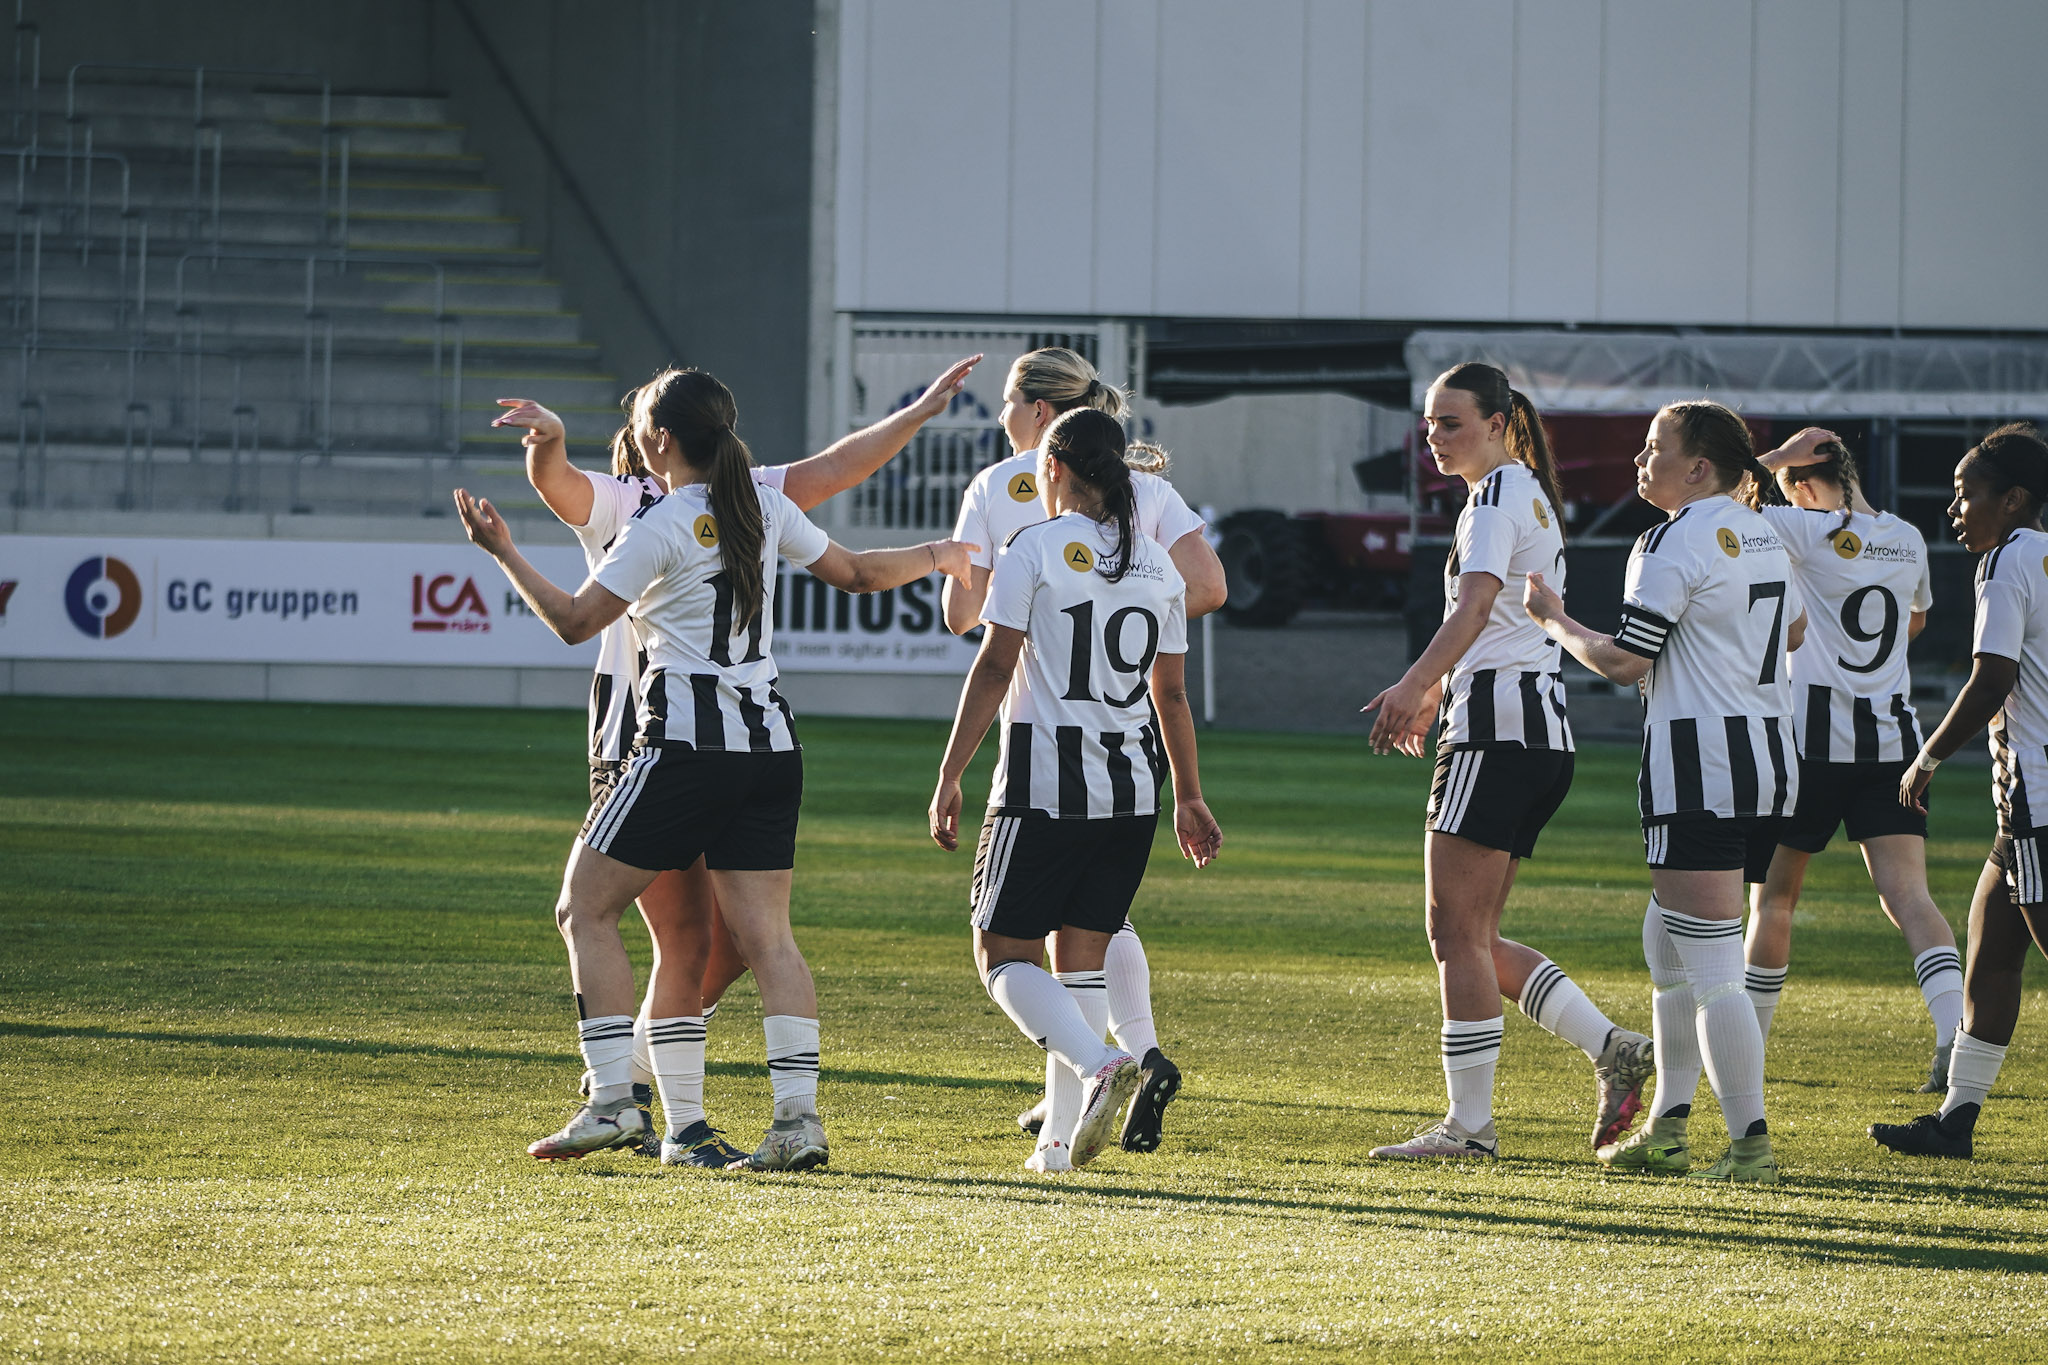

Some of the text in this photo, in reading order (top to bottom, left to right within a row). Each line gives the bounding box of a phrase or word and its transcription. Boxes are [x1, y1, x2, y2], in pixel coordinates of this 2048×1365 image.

[1098, 556, 1164, 577] Arrwlake
[1864, 540, 1917, 559] Arrowlake
[167, 579, 359, 621] GC gruppen
[412, 574, 488, 617] ICA
[1748, 581, 1786, 686] 7
[1837, 585, 1899, 674] 9
[1060, 600, 1159, 709] 19
